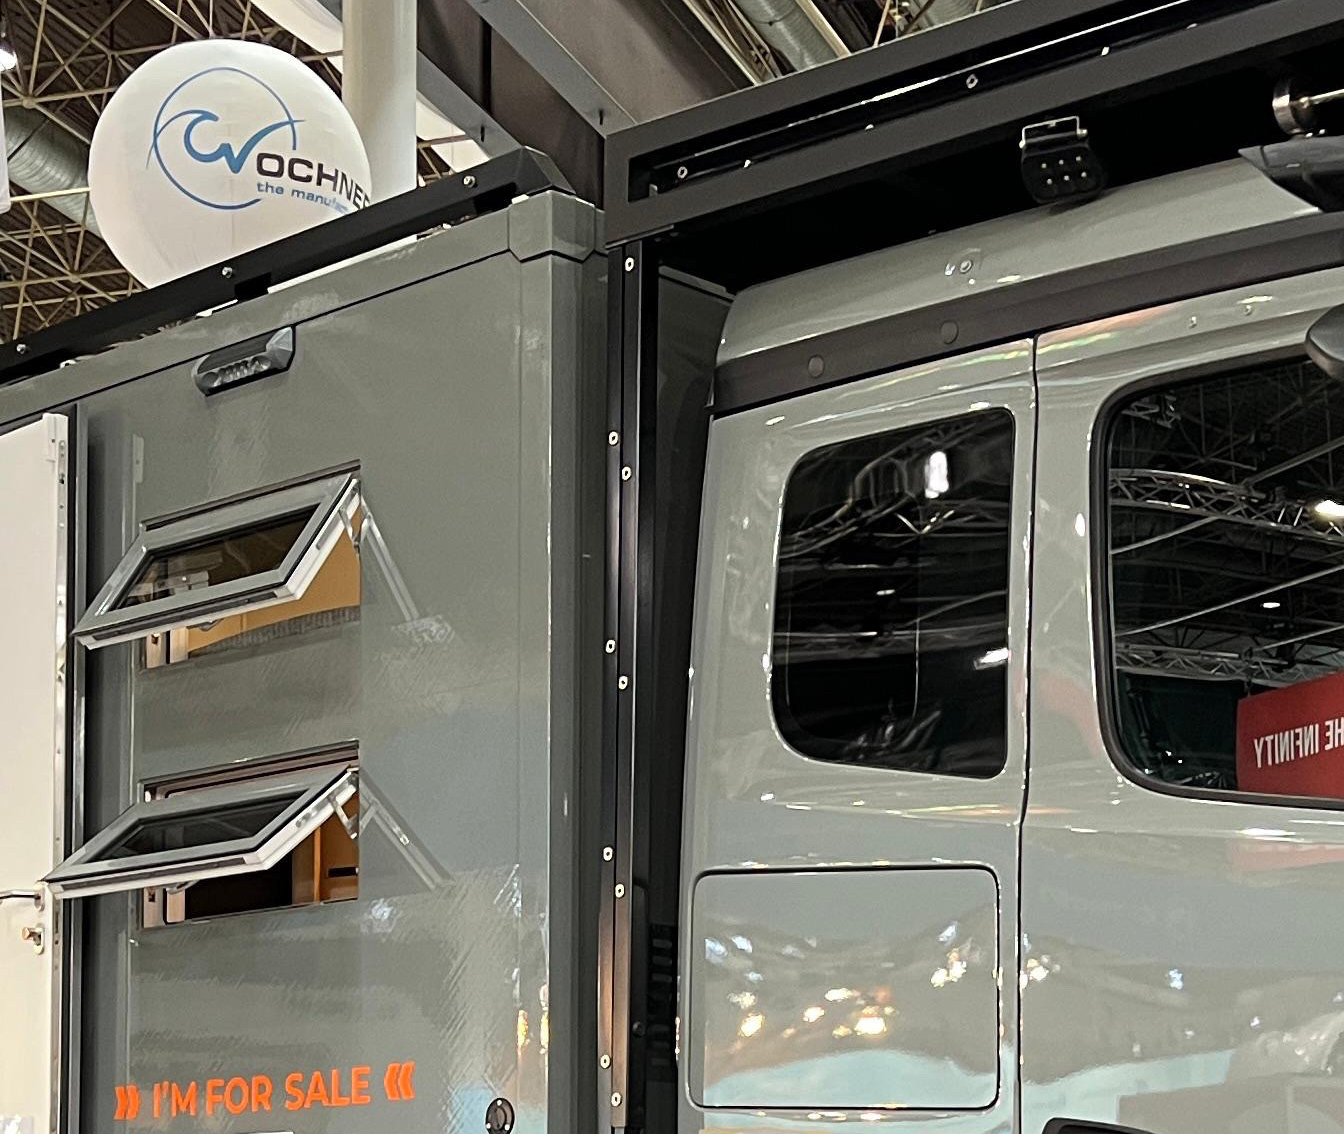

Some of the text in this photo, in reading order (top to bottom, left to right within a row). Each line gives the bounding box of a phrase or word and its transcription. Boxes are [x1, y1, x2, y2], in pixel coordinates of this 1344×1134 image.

[257, 182, 284, 195] the
[153, 1066, 372, 1118] I'M FOR SALE
